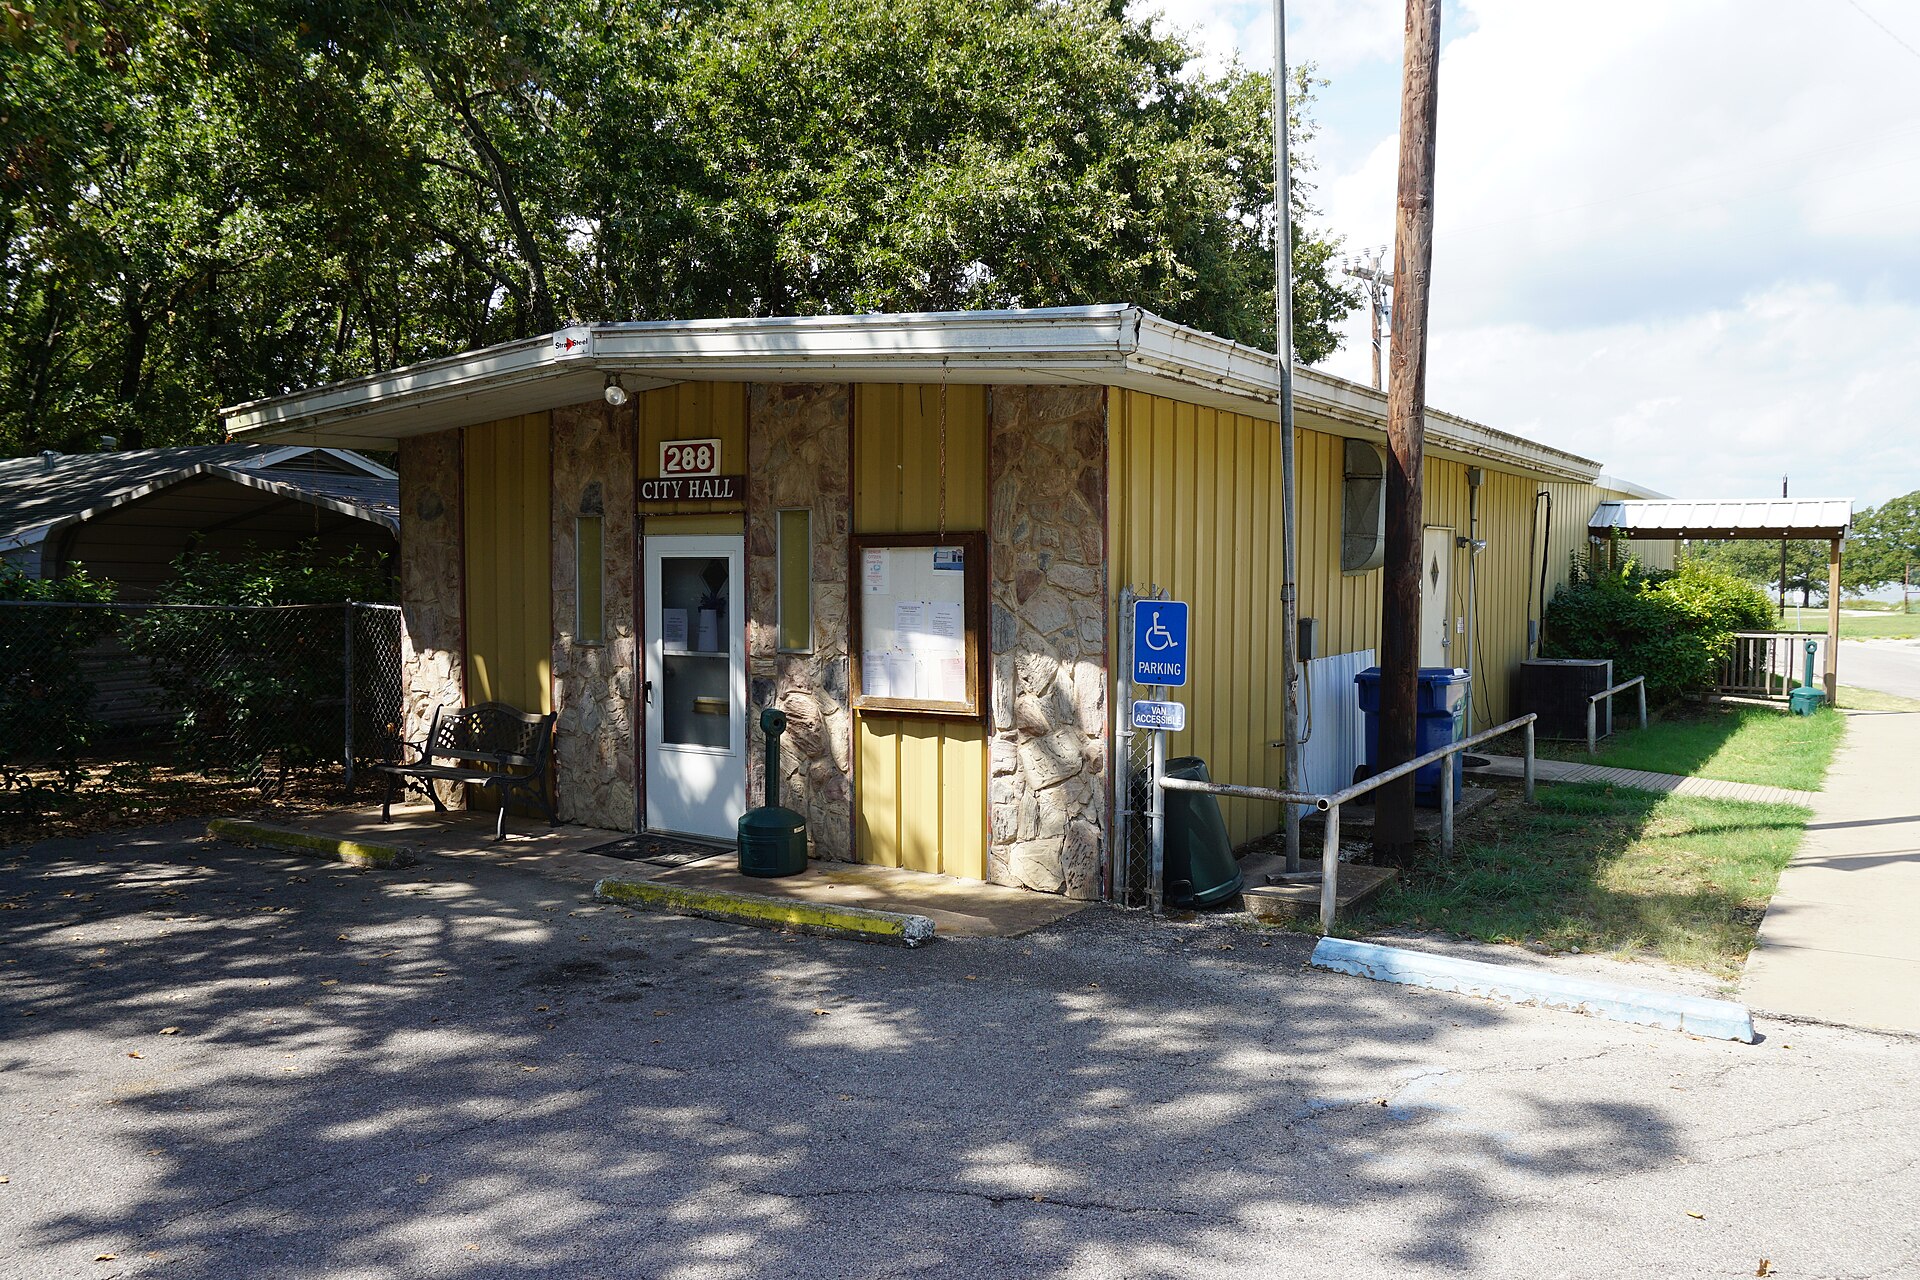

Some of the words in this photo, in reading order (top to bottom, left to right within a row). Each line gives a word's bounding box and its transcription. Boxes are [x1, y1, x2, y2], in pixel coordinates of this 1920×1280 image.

[572, 338, 588, 346] Steel
[667, 446, 711, 470] 288
[642, 481, 683, 499] CITY
[688, 479, 734, 498] HALL
[1138, 662, 1181, 676] PARKING
[1151, 706, 1166, 715] VAN
[1136, 714, 1182, 725] ACCESSIBLE
